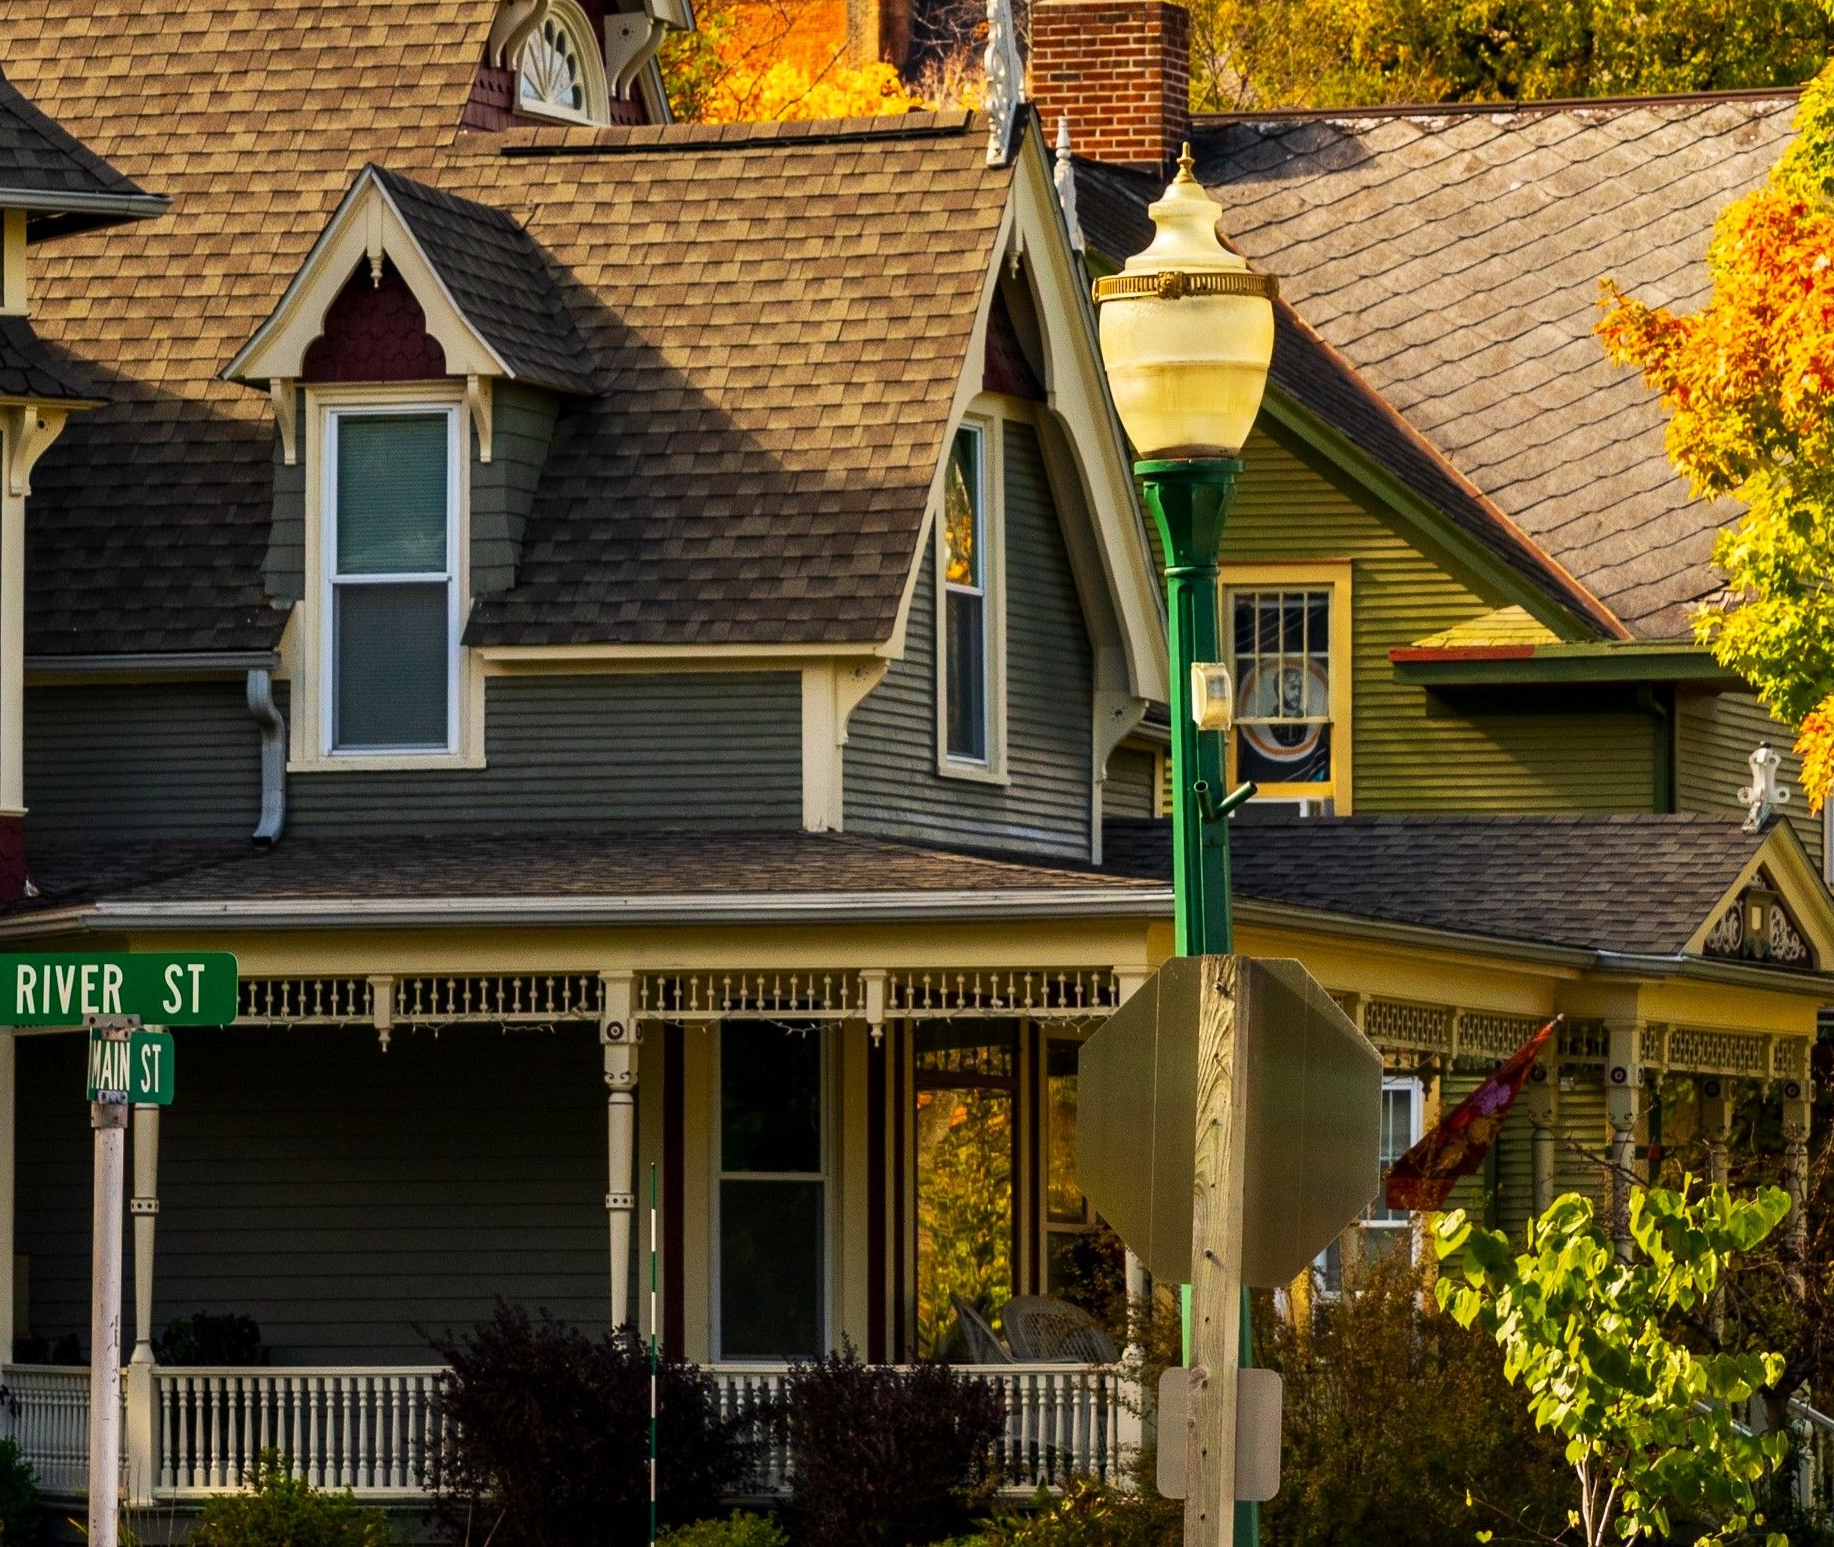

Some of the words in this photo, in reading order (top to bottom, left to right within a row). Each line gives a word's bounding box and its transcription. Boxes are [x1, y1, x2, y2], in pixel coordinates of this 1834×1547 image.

[16, 964, 123, 1014] RIVER
[162, 964, 205, 1014] ST
[91, 1040, 130, 1091] MAIN
[141, 1043, 161, 1093] ST
